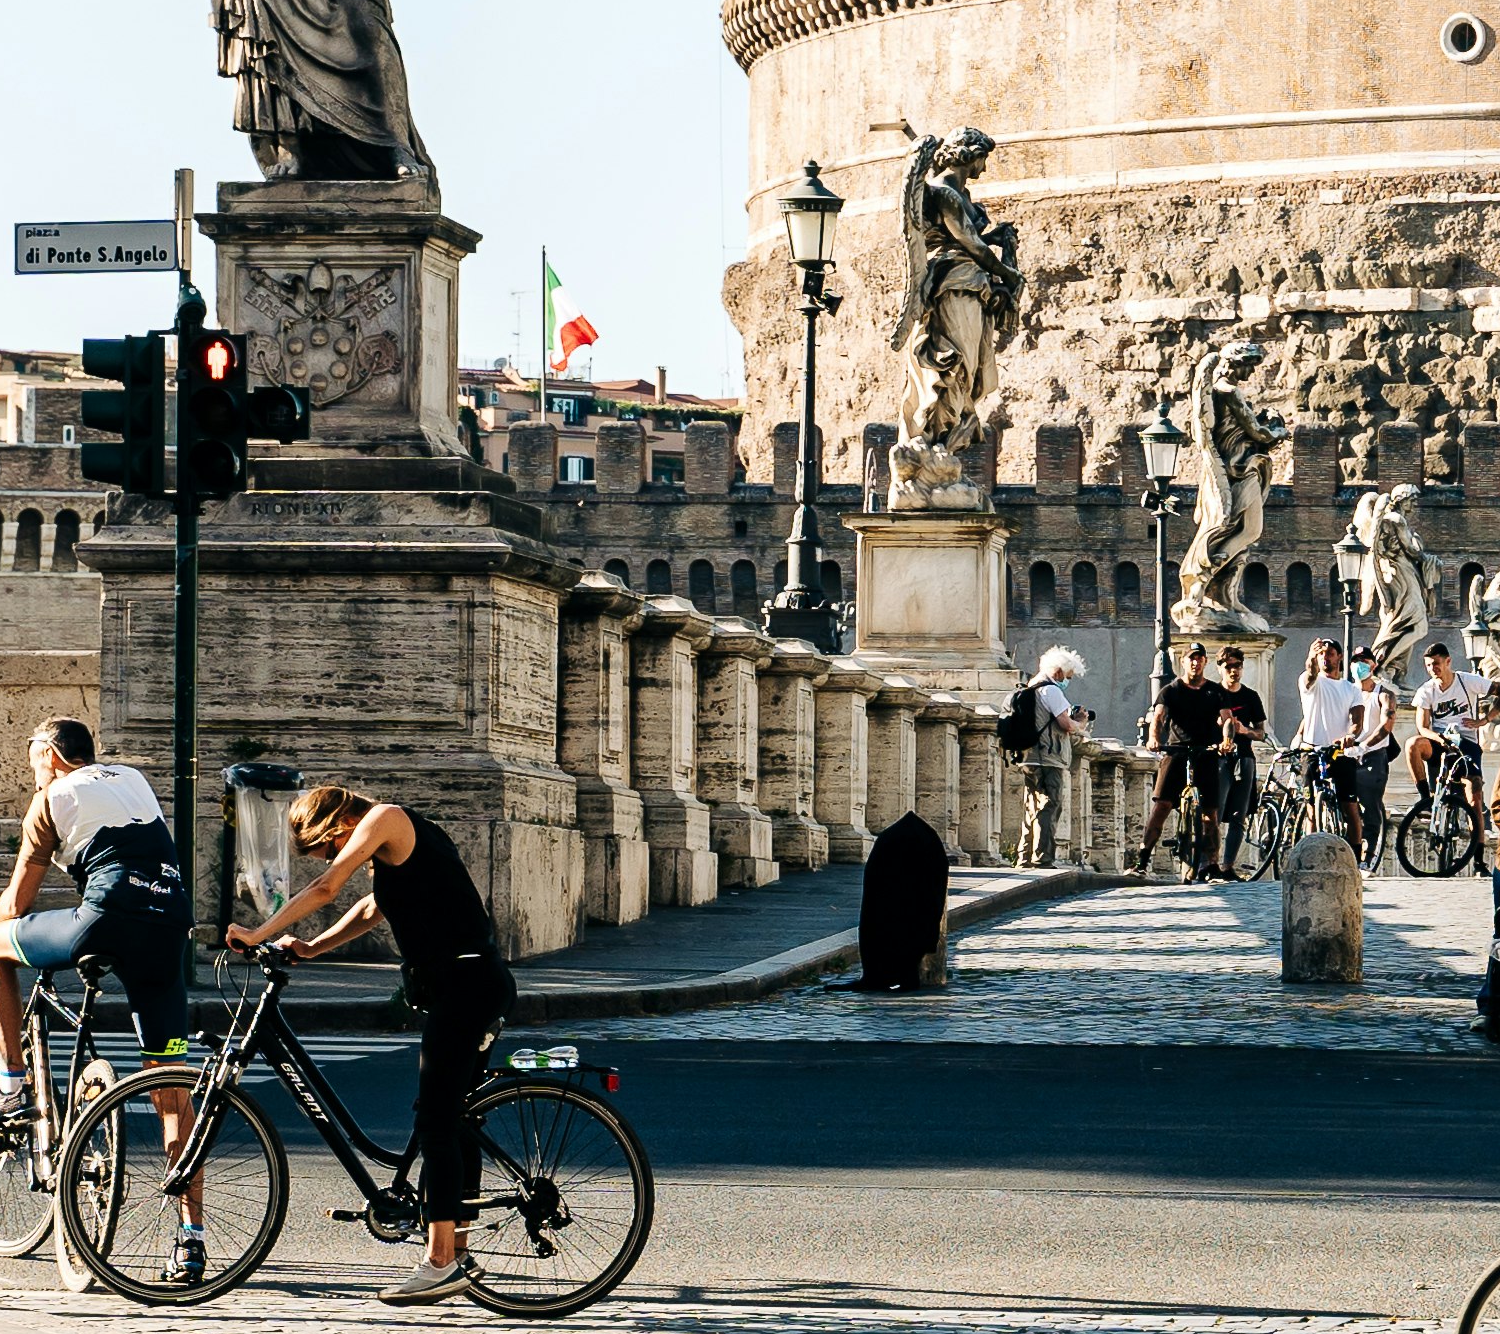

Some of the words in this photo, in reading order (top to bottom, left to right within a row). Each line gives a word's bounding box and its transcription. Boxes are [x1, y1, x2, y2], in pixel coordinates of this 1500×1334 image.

[25, 227, 60, 239] piazza
[25, 247, 40, 264] di
[47, 247, 92, 264] Ponte
[250, 502, 311, 515] RIONE
[280, 1062, 330, 1123] GALANT
